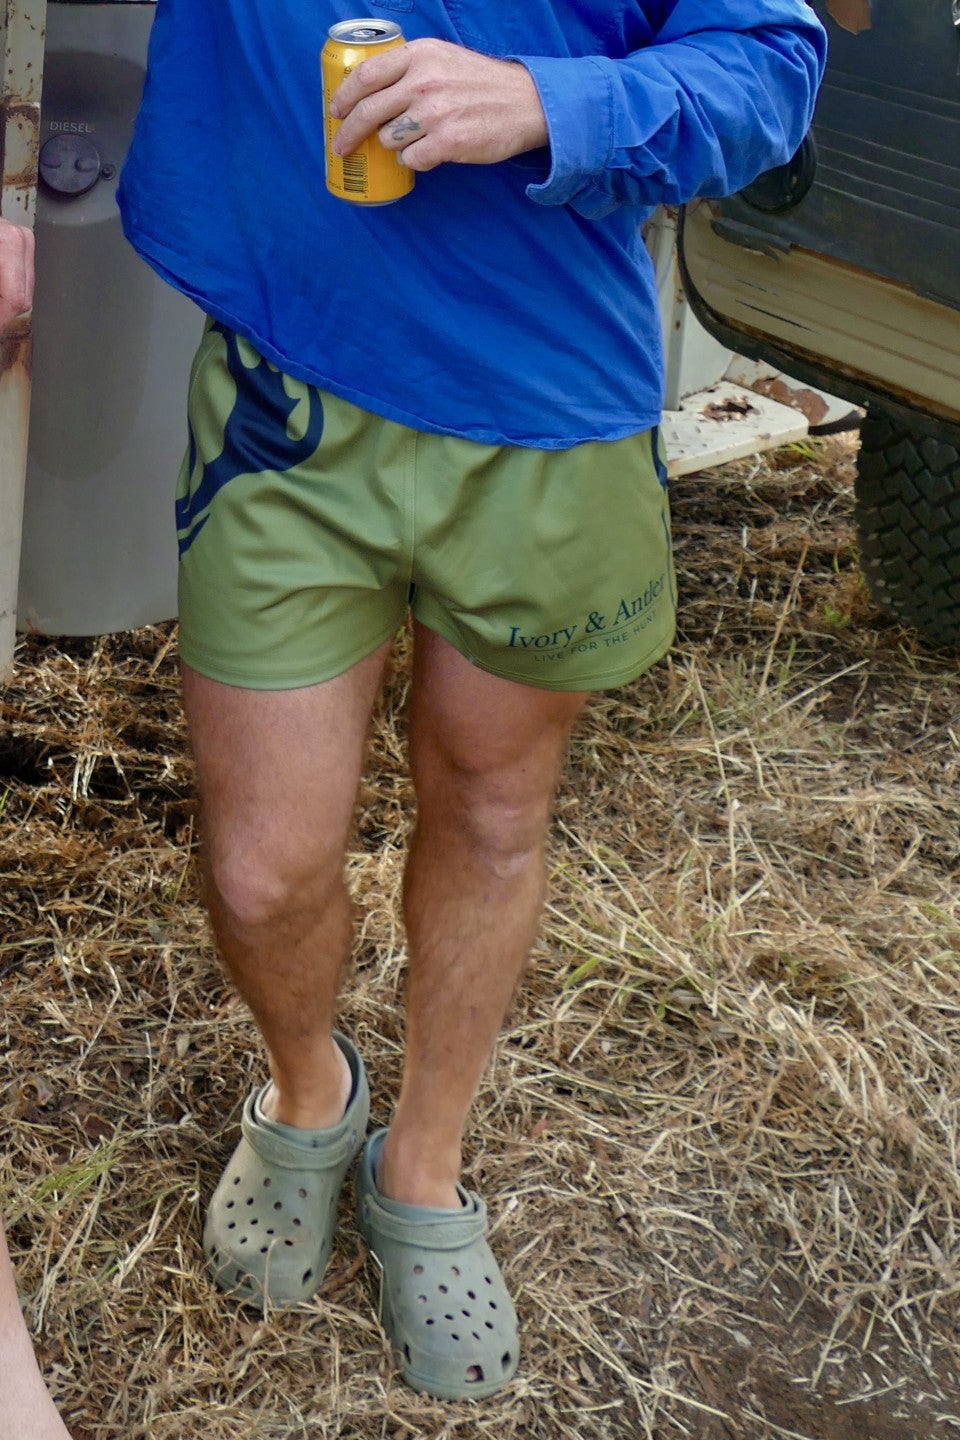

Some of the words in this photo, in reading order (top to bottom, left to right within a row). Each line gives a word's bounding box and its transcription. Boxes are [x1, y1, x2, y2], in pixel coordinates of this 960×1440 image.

[49, 121, 92, 134] DIESEL
[507, 624, 578, 648] Ivory
[584, 611, 606, 634] &
[612, 573, 666, 626] Antler
[534, 651, 565, 662] LIVE
[570, 641, 598, 655] FOR
[603, 632, 629, 648] THE
[633, 609, 658, 635] HUNT
